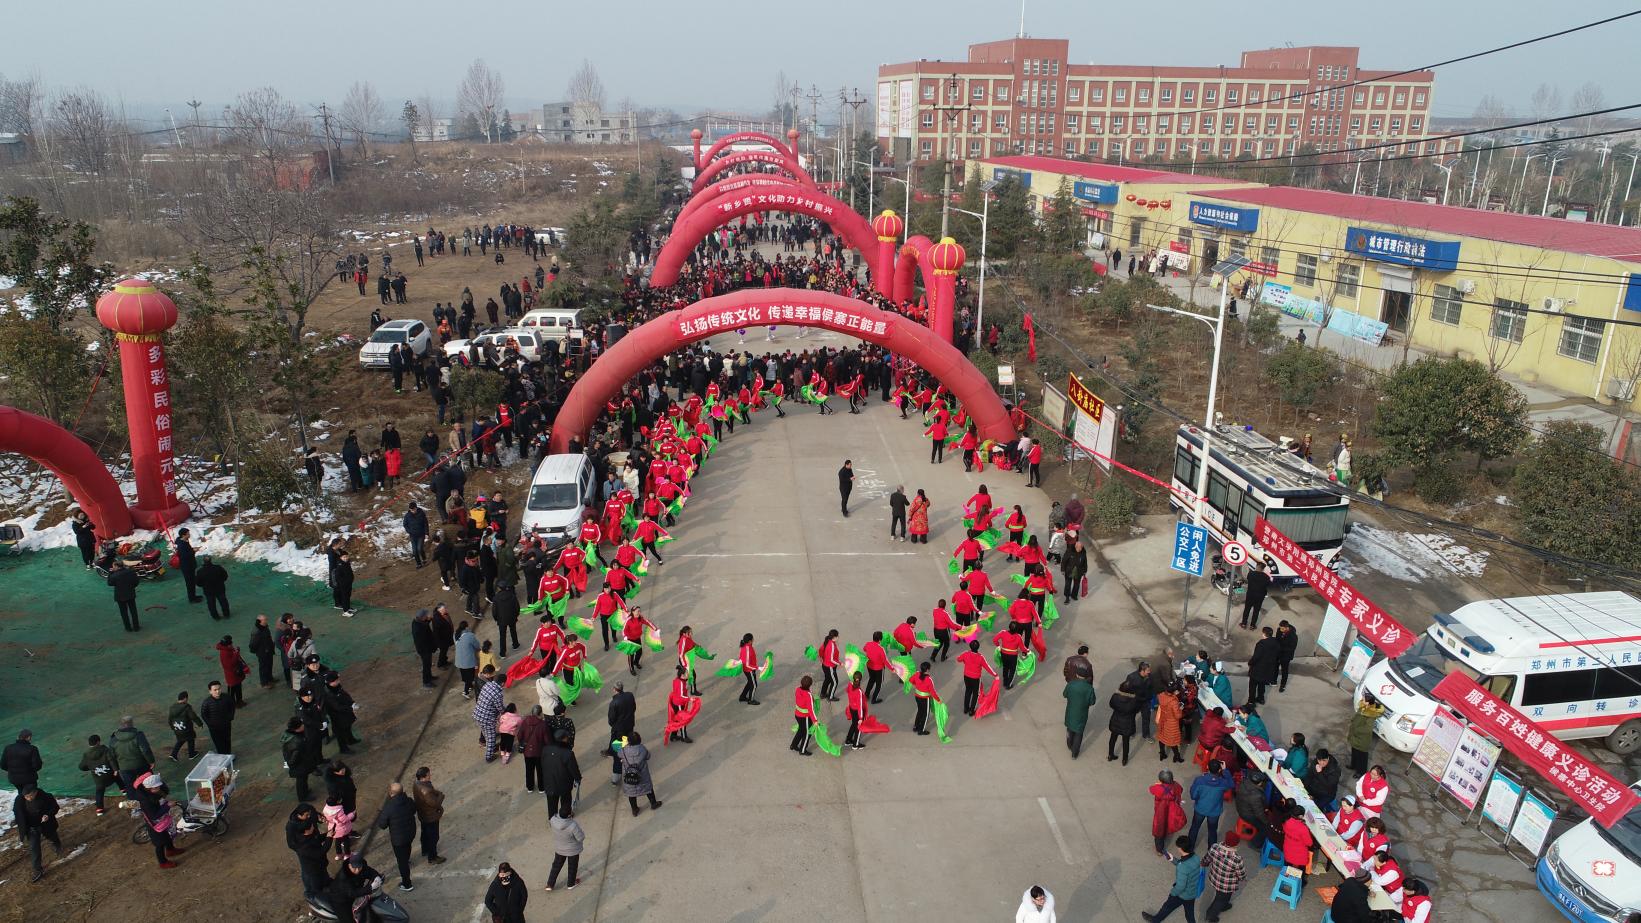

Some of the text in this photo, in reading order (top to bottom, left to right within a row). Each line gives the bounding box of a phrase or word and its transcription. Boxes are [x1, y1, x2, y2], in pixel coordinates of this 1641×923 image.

[1369, 235, 1426, 257] 城市管理行政执法
[680, 304, 887, 336] 弘扬传统文化 传递幸福侯寨正能量
[148, 345, 176, 498] 多彩民俗闹元宵
[1176, 526, 1191, 569] 公交厂区
[1188, 530, 1203, 573] 闲人免进
[1230, 546, 1240, 561] 5
[1261, 535, 1336, 598] 郑州市第二人民医院
[1337, 585, 1401, 645] 专家义诊
[1463, 687, 1622, 805] 服务百姓健康义诊活动
